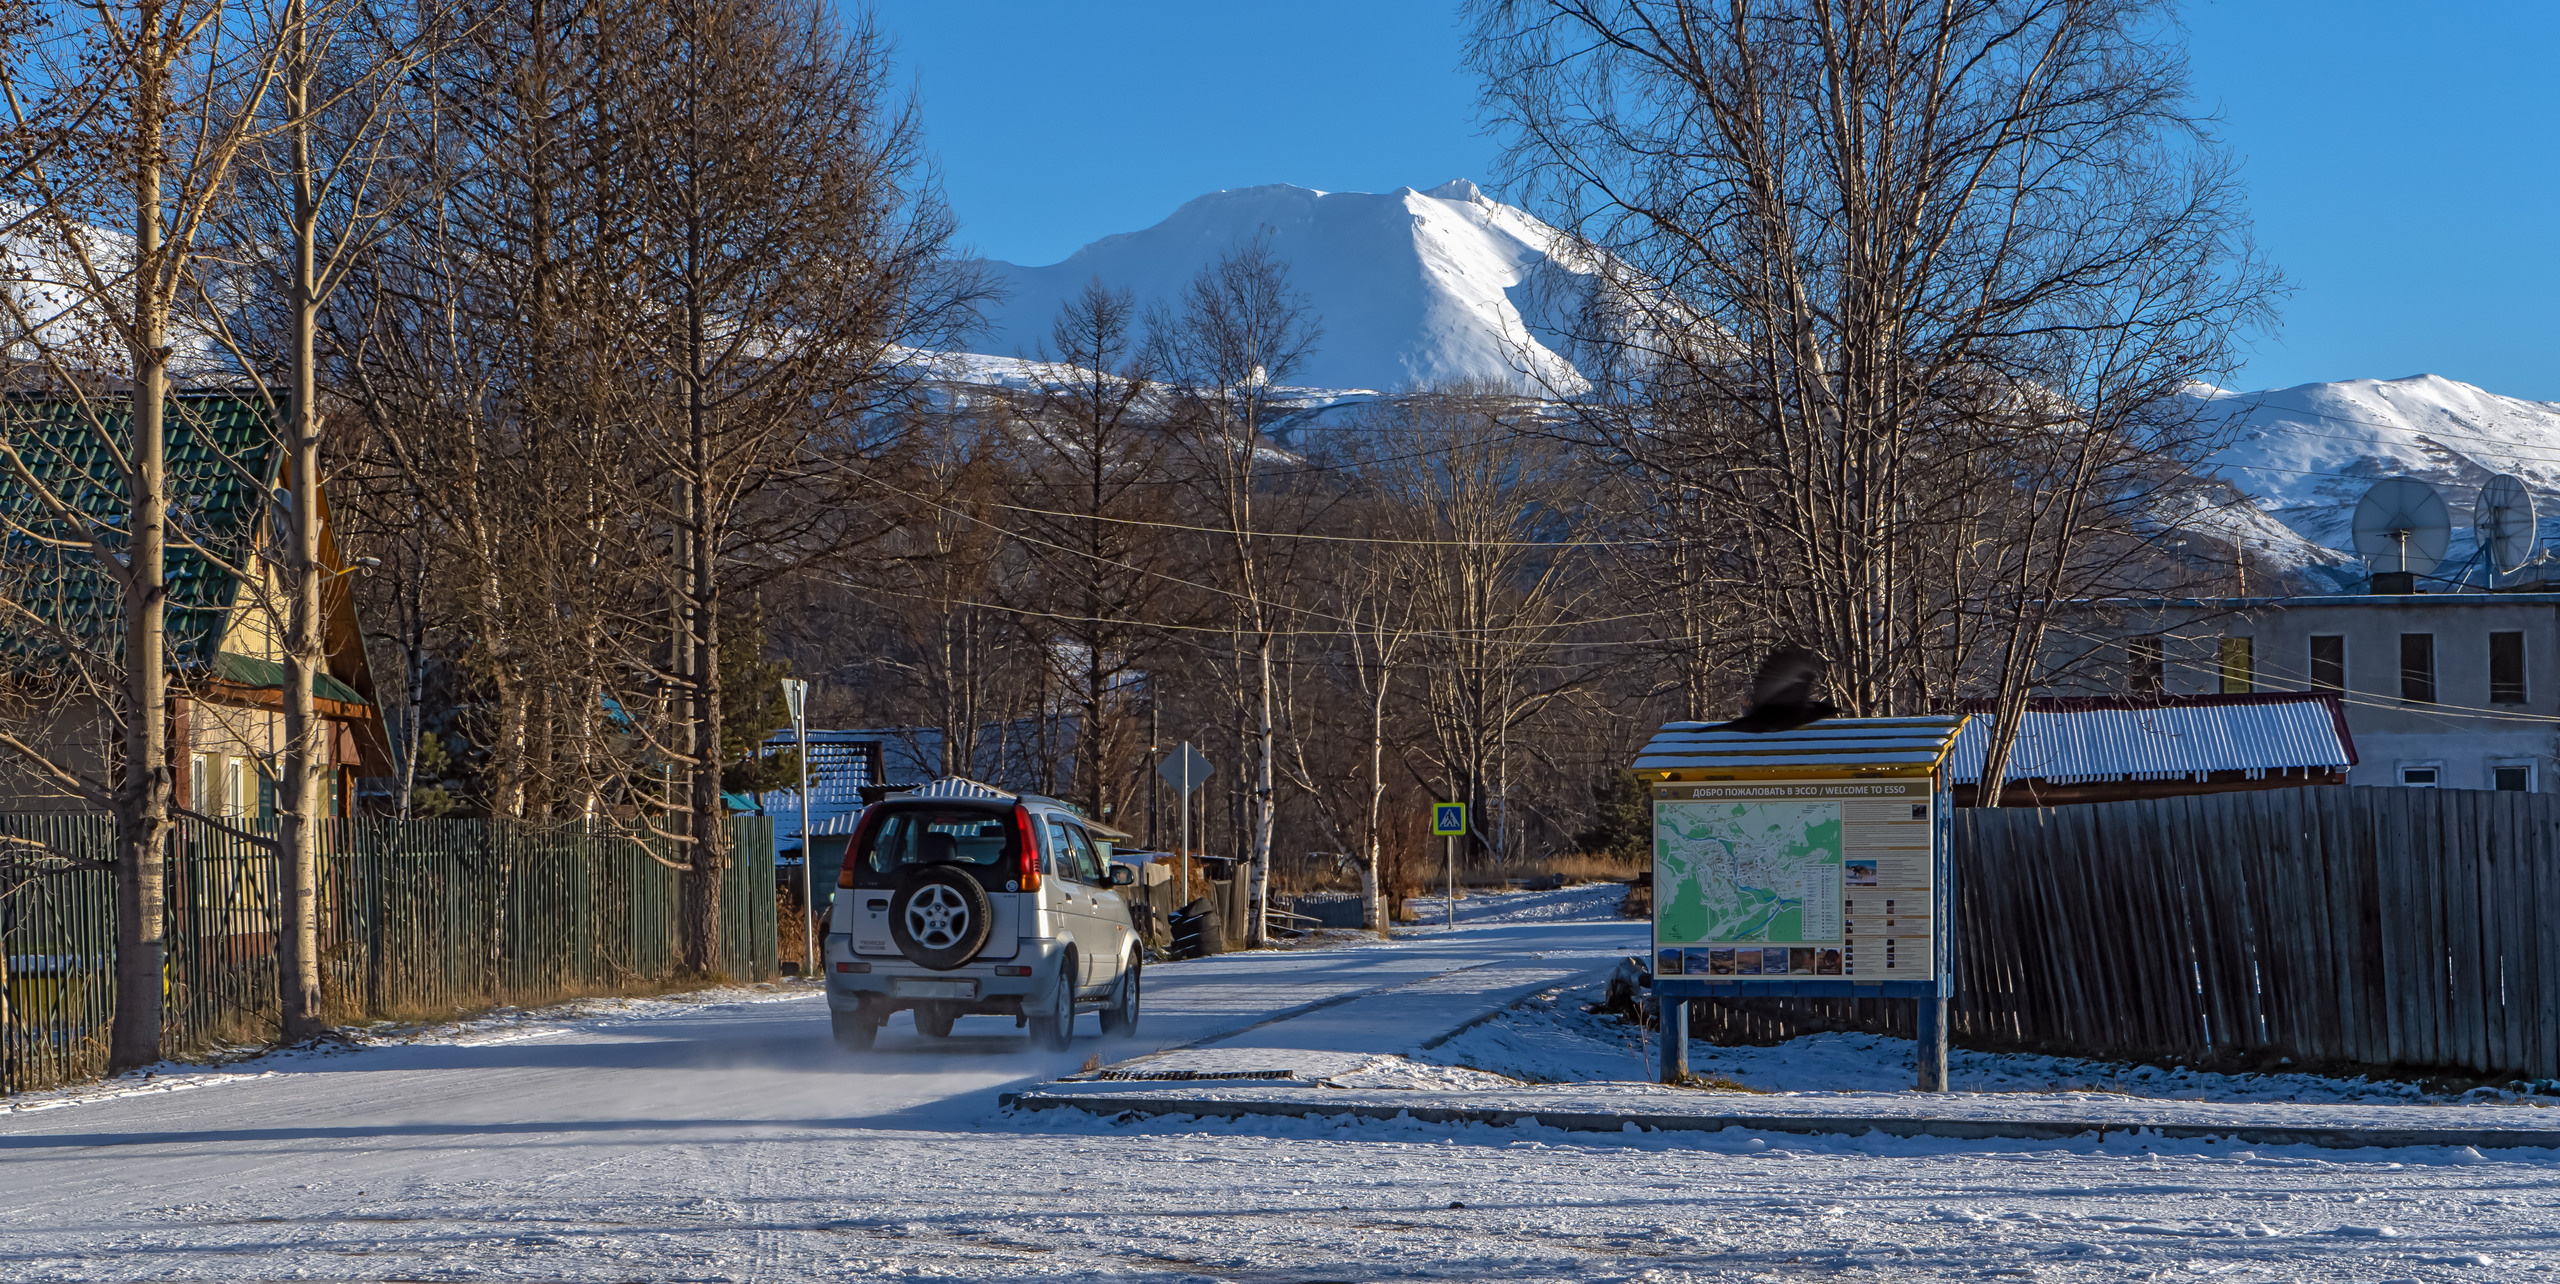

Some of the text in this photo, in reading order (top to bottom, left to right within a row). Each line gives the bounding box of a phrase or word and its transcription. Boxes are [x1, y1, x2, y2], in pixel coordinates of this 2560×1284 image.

[1692, 788, 1723, 798] ДОБРО
[1725, 787, 1785, 796] ПОЖАЛОВАТЬ
[1787, 787, 1793, 795] В
[1795, 787, 1817, 795] ЭССО
[1825, 786, 1869, 795] WELCOME
[1871, 786, 1882, 794] TO
[1884, 785, 1906, 794] ESSO
